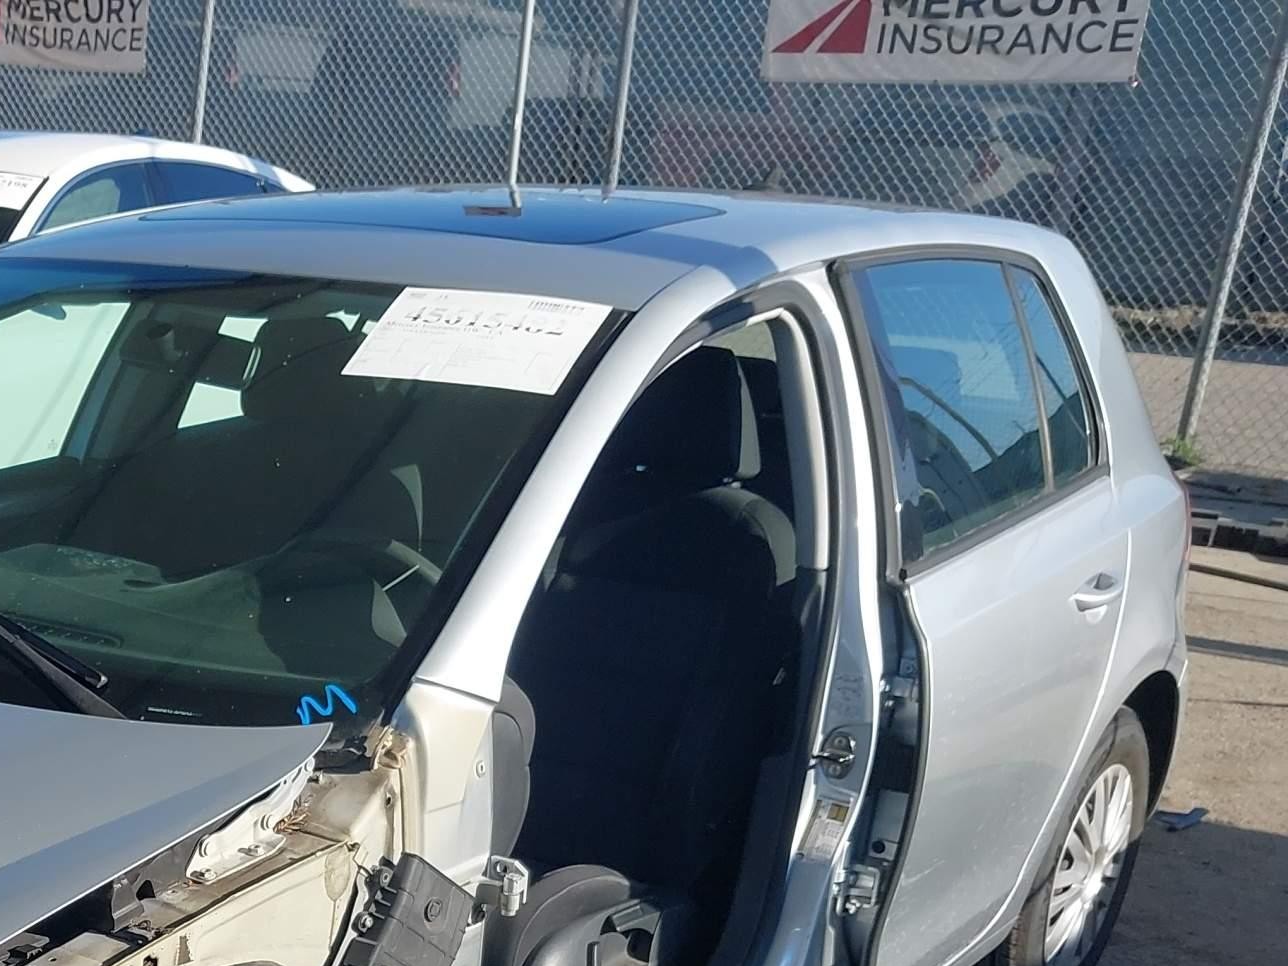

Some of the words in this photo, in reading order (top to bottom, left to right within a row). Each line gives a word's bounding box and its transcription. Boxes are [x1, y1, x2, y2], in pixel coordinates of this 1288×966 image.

[6, 0, 143, 23] MERCURY
[5, 22, 144, 52] INSURANCE
[876, 19, 1140, 54] INSURANCE
